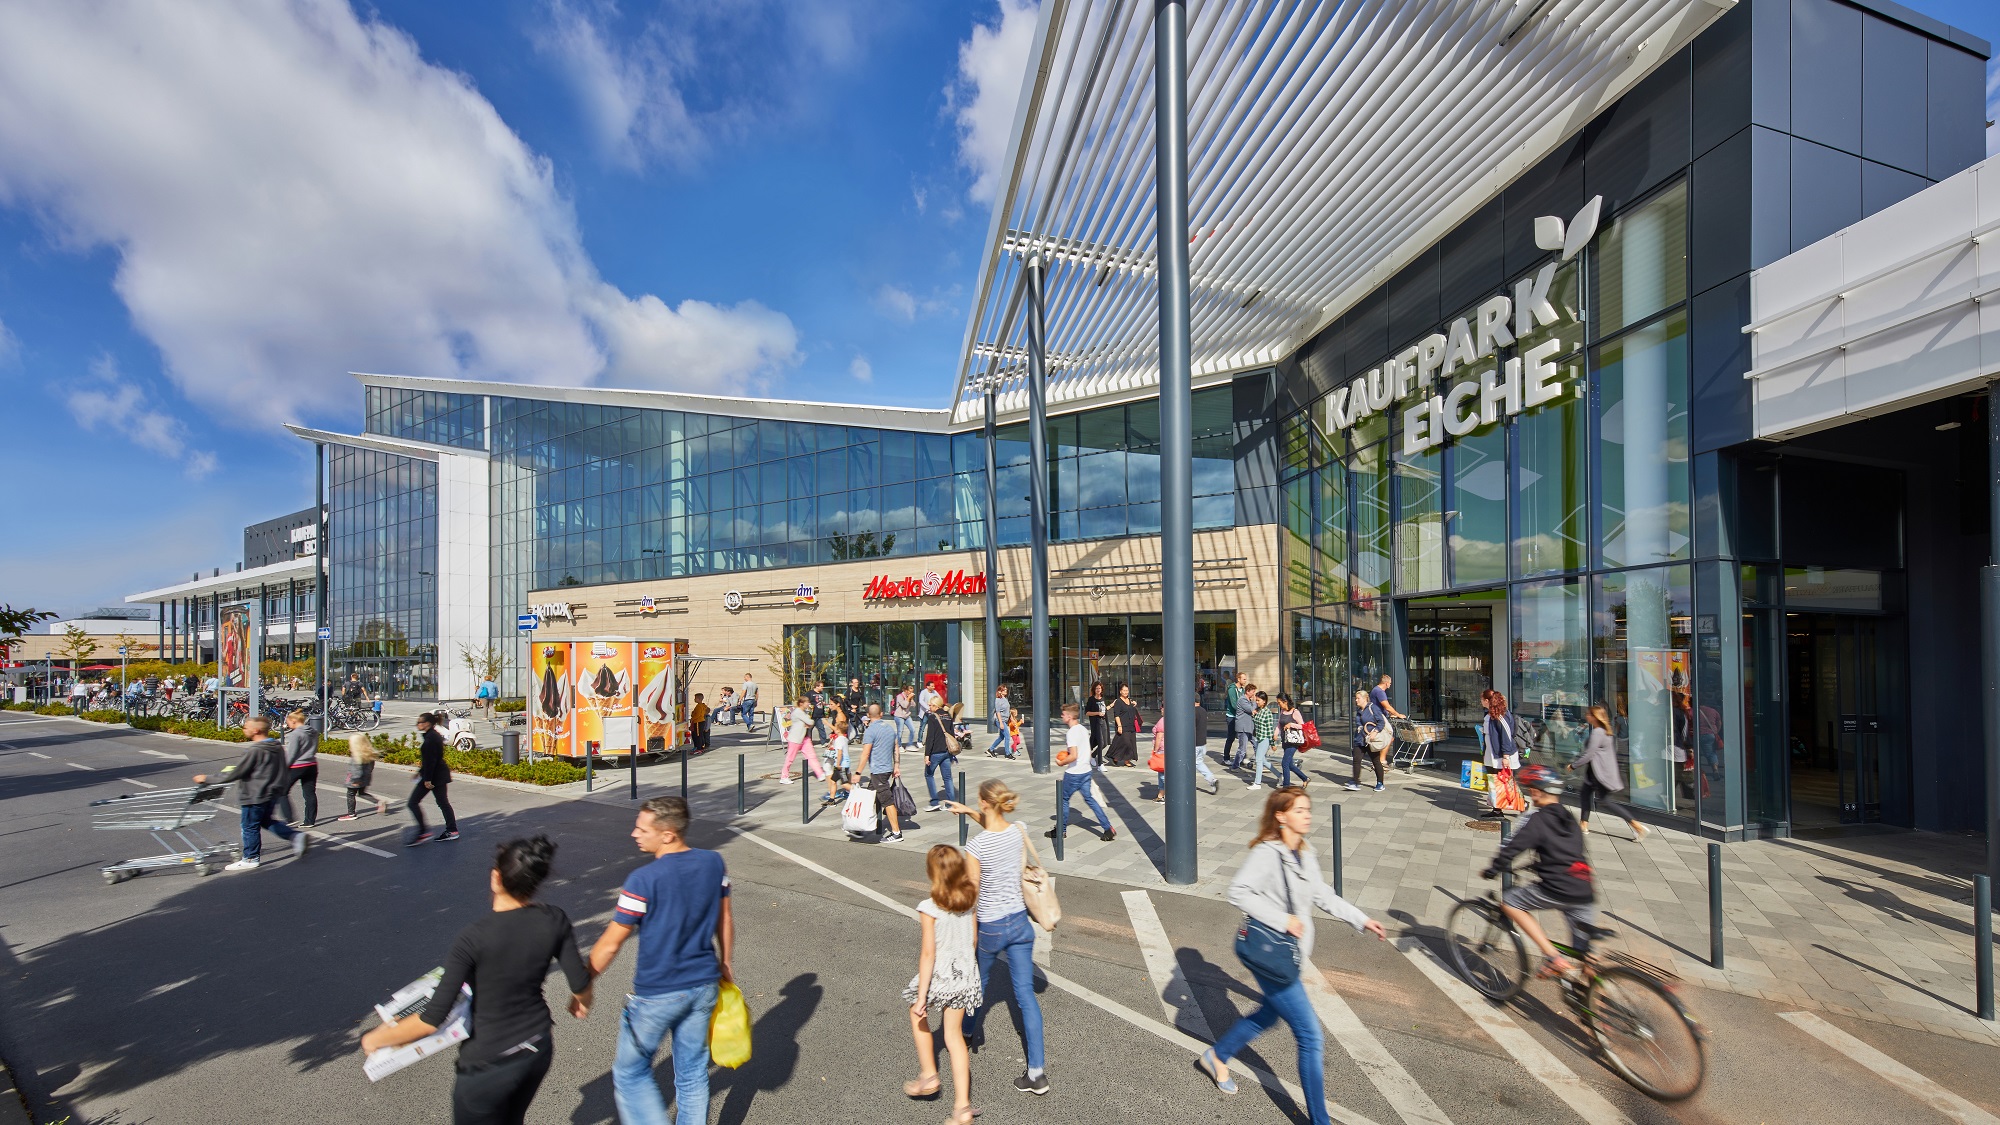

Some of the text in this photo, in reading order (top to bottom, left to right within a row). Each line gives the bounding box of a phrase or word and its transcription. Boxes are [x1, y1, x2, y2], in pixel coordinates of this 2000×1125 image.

[1325, 262, 1559, 435] KAUFPARK
[1404, 338, 1562, 455] EICHE
[798, 583, 812, 597] dm
[863, 569, 987, 600] Media Mark
[641, 595, 653, 607] dm
